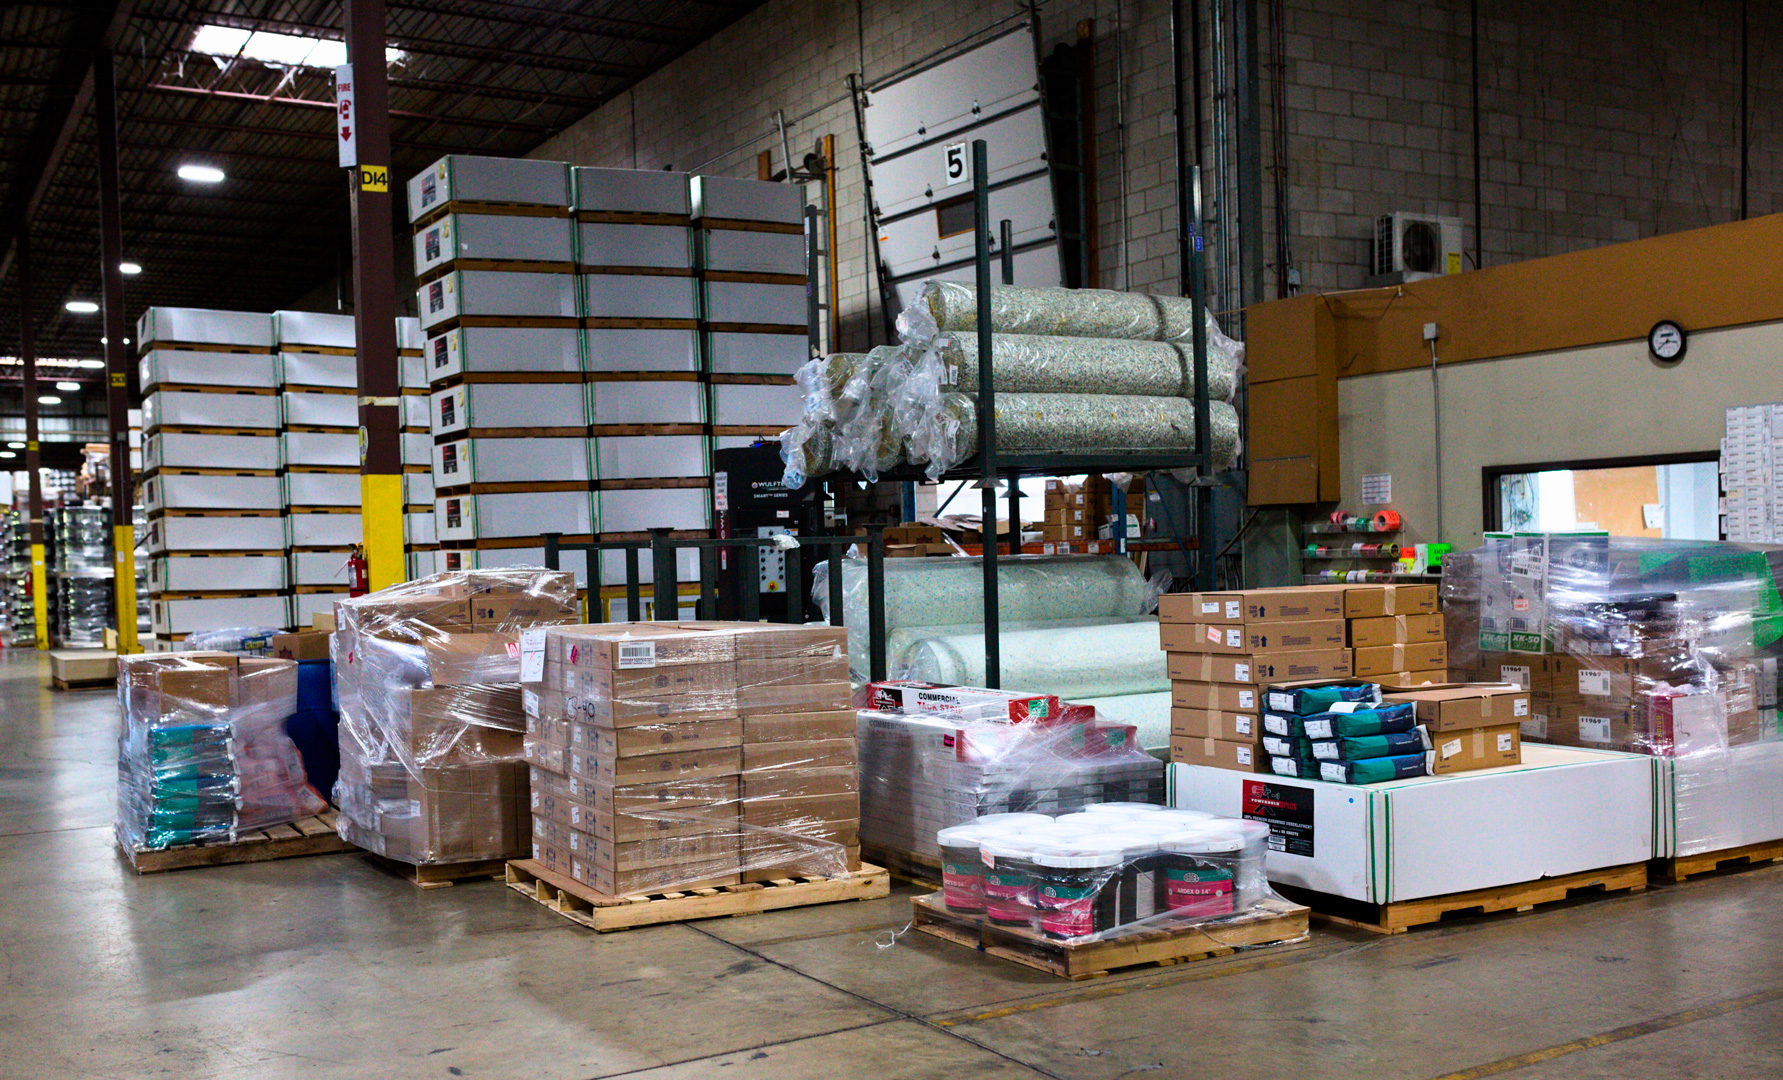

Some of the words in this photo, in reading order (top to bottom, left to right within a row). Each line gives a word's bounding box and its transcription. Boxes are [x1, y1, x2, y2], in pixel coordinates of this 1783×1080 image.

[338, 82, 351, 92] FIRE
[947, 148, 963, 178] 5
[362, 171, 388, 186] D14
[1513, 634, 1540, 643] XK-50
[918, 692, 960, 704] COMMERCIAL
